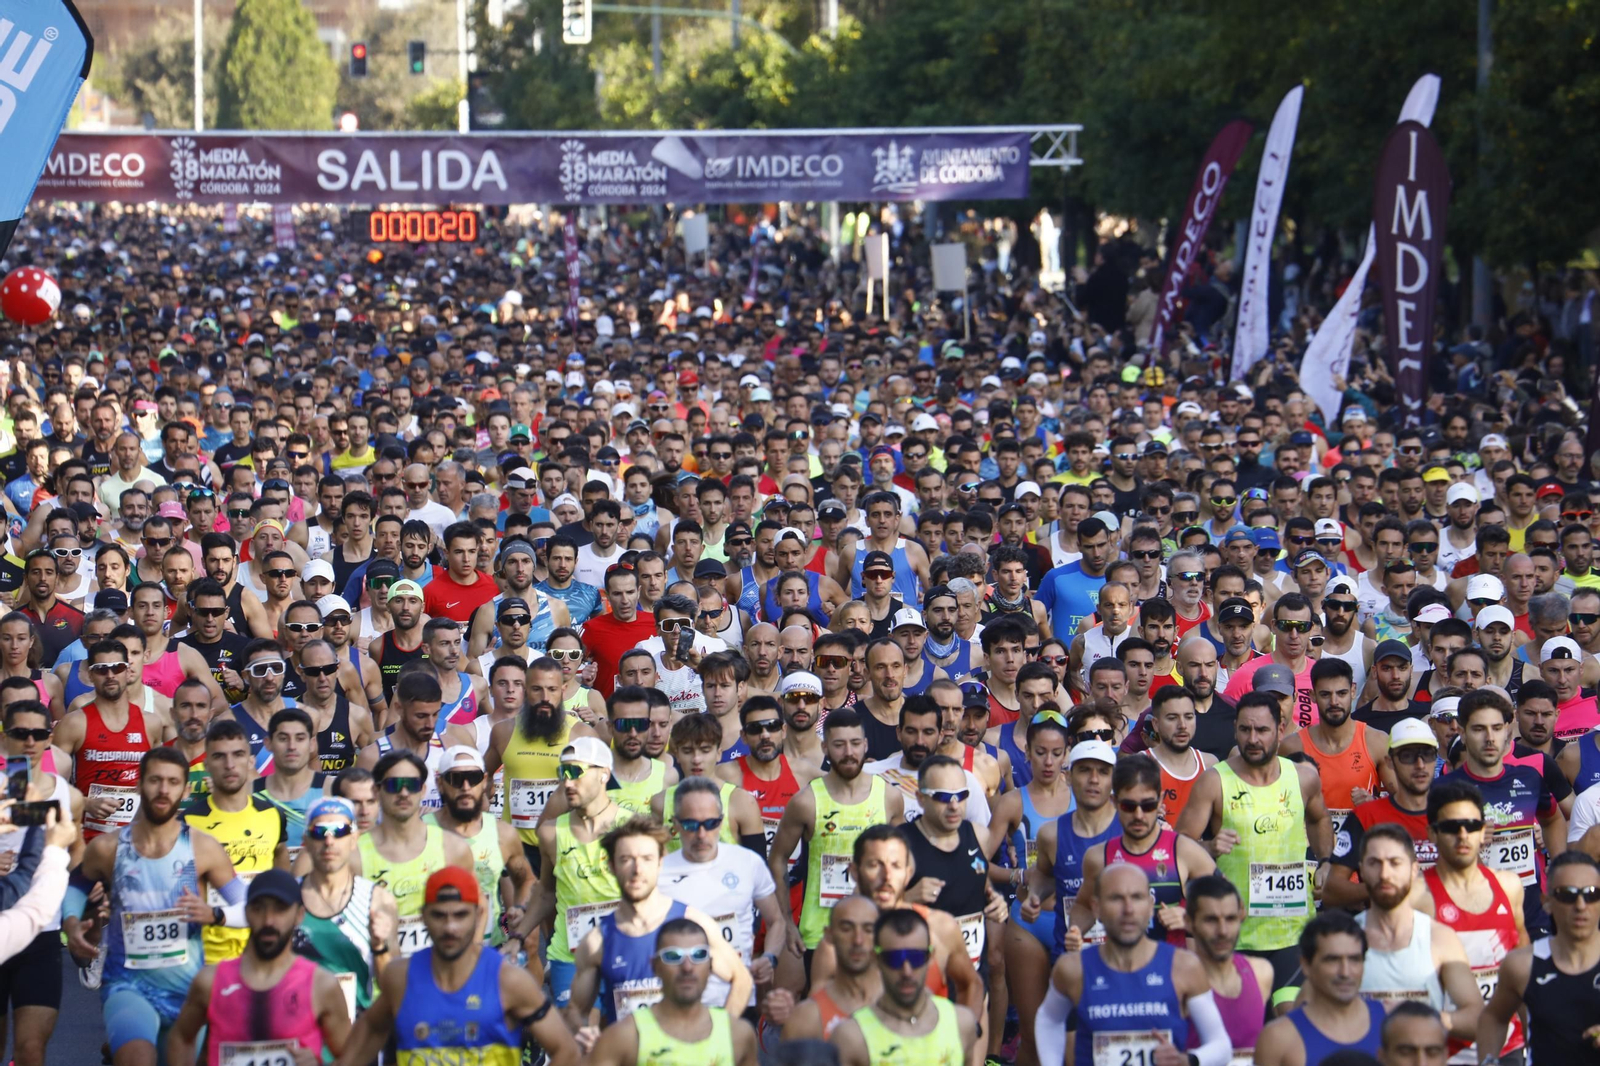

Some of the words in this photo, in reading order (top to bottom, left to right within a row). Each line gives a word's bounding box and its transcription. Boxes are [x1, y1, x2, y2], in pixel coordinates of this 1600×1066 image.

[45, 152, 146, 178] MDECO
[200, 148, 249, 164] MEDIA
[587, 151, 637, 166] MEDIA
[919, 146, 1021, 165] AYUNTAMIENTO
[200, 158, 281, 180] MARATÓN
[316, 149, 508, 191] SALIDA
[587, 161, 668, 182] MARATÓN
[736, 154, 844, 178] IMDECO
[920, 167, 938, 183] DE
[200, 182, 249, 195] CÓRDOBA
[253, 182, 281, 195] 2024
[640, 183, 668, 196] 2024
[1161, 161, 1222, 322] IMDECO
[669, 689, 700, 702] ratón
[1298, 688, 1312, 727] RDOBA
[1499, 844, 1530, 863] 269
[1265, 874, 1305, 891] 1465
[144, 922, 179, 942] 838
[962, 928, 978, 945] 21
[1087, 1001, 1169, 1020] TROTASIERRA
